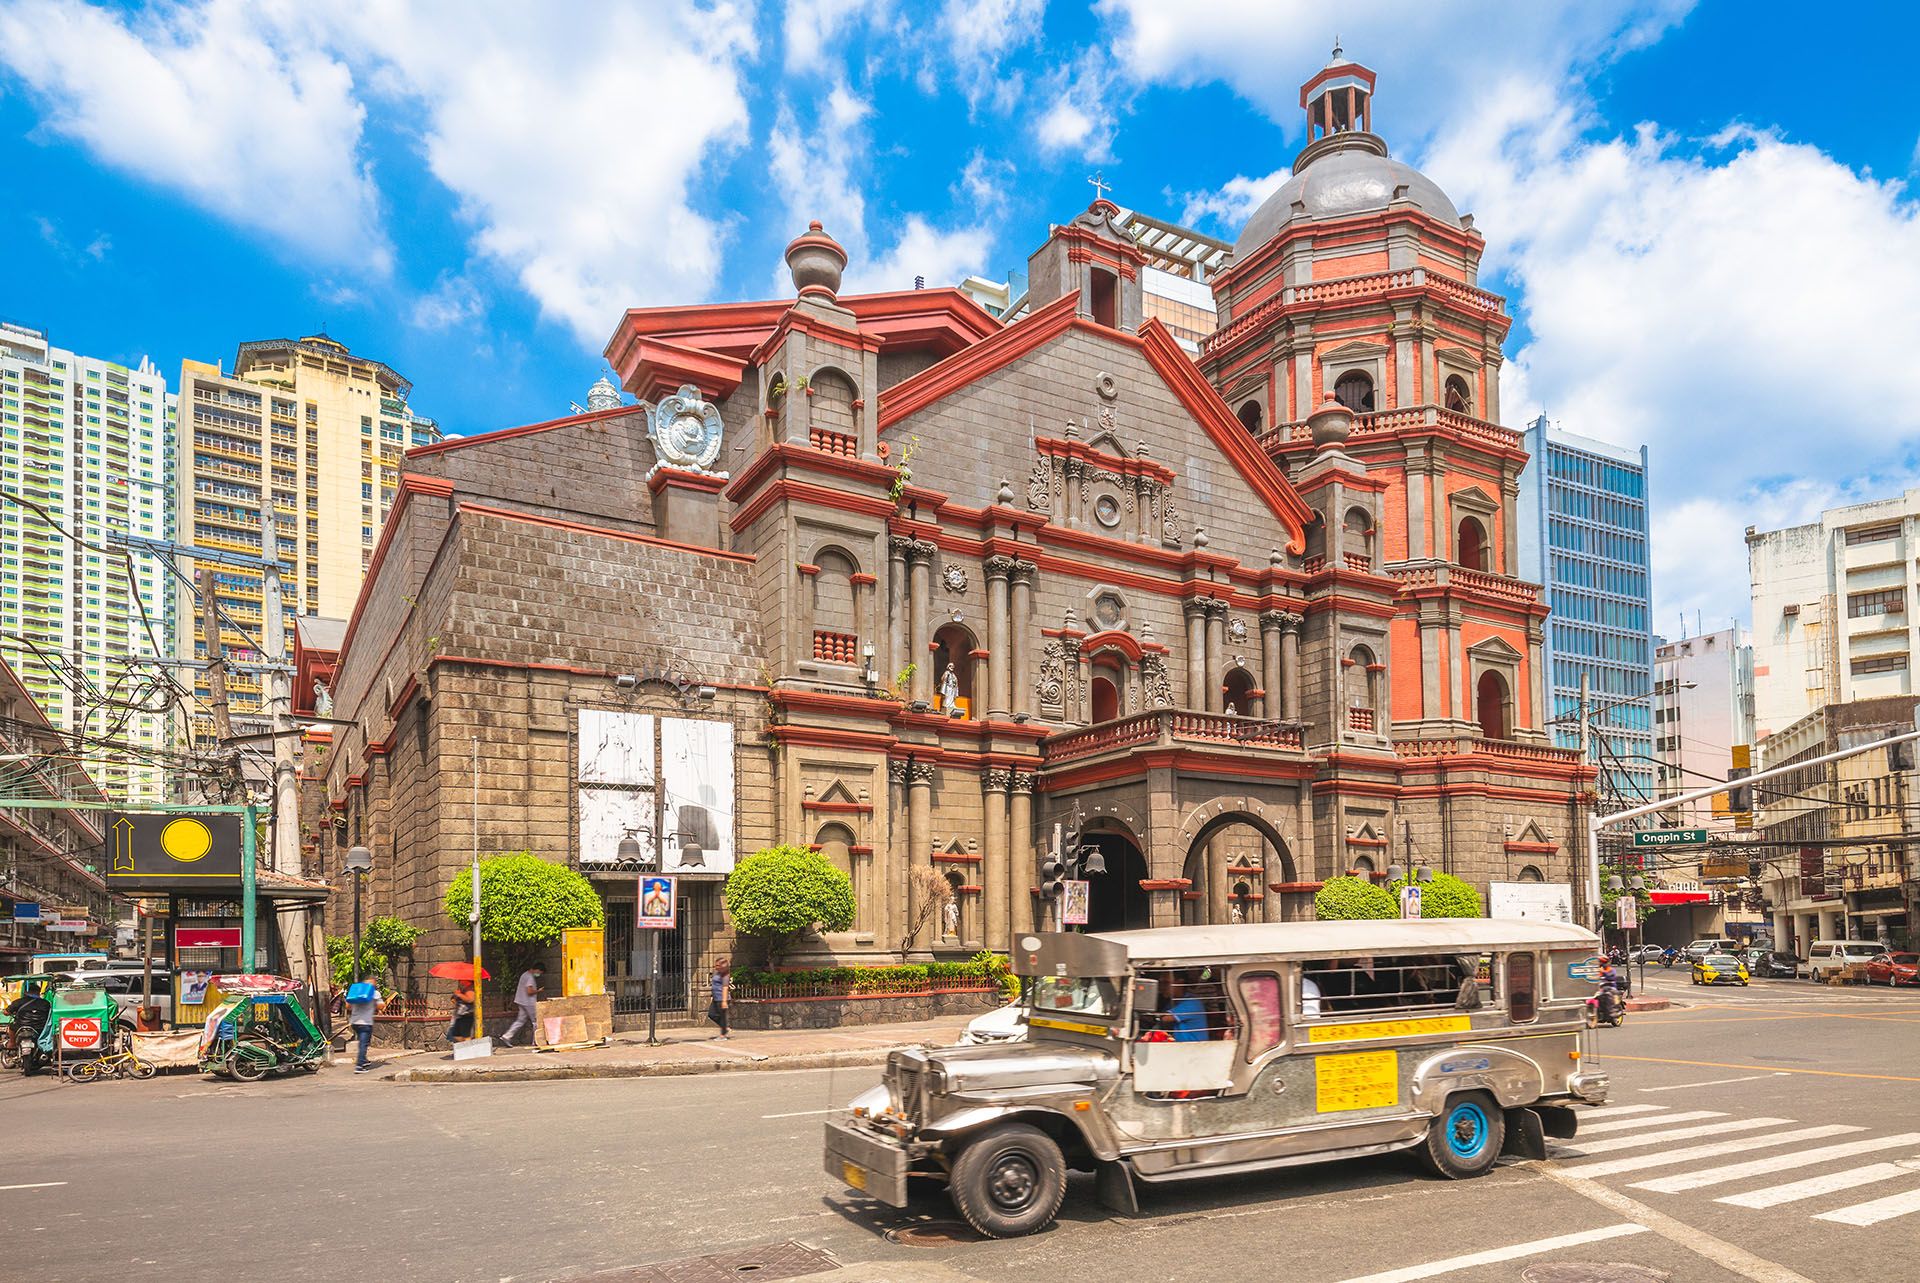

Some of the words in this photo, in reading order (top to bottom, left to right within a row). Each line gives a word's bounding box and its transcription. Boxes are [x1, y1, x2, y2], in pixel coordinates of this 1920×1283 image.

[1642, 833, 1680, 844] Ongpin
[1683, 832, 1696, 841] St
[74, 1023, 89, 1031] NO
